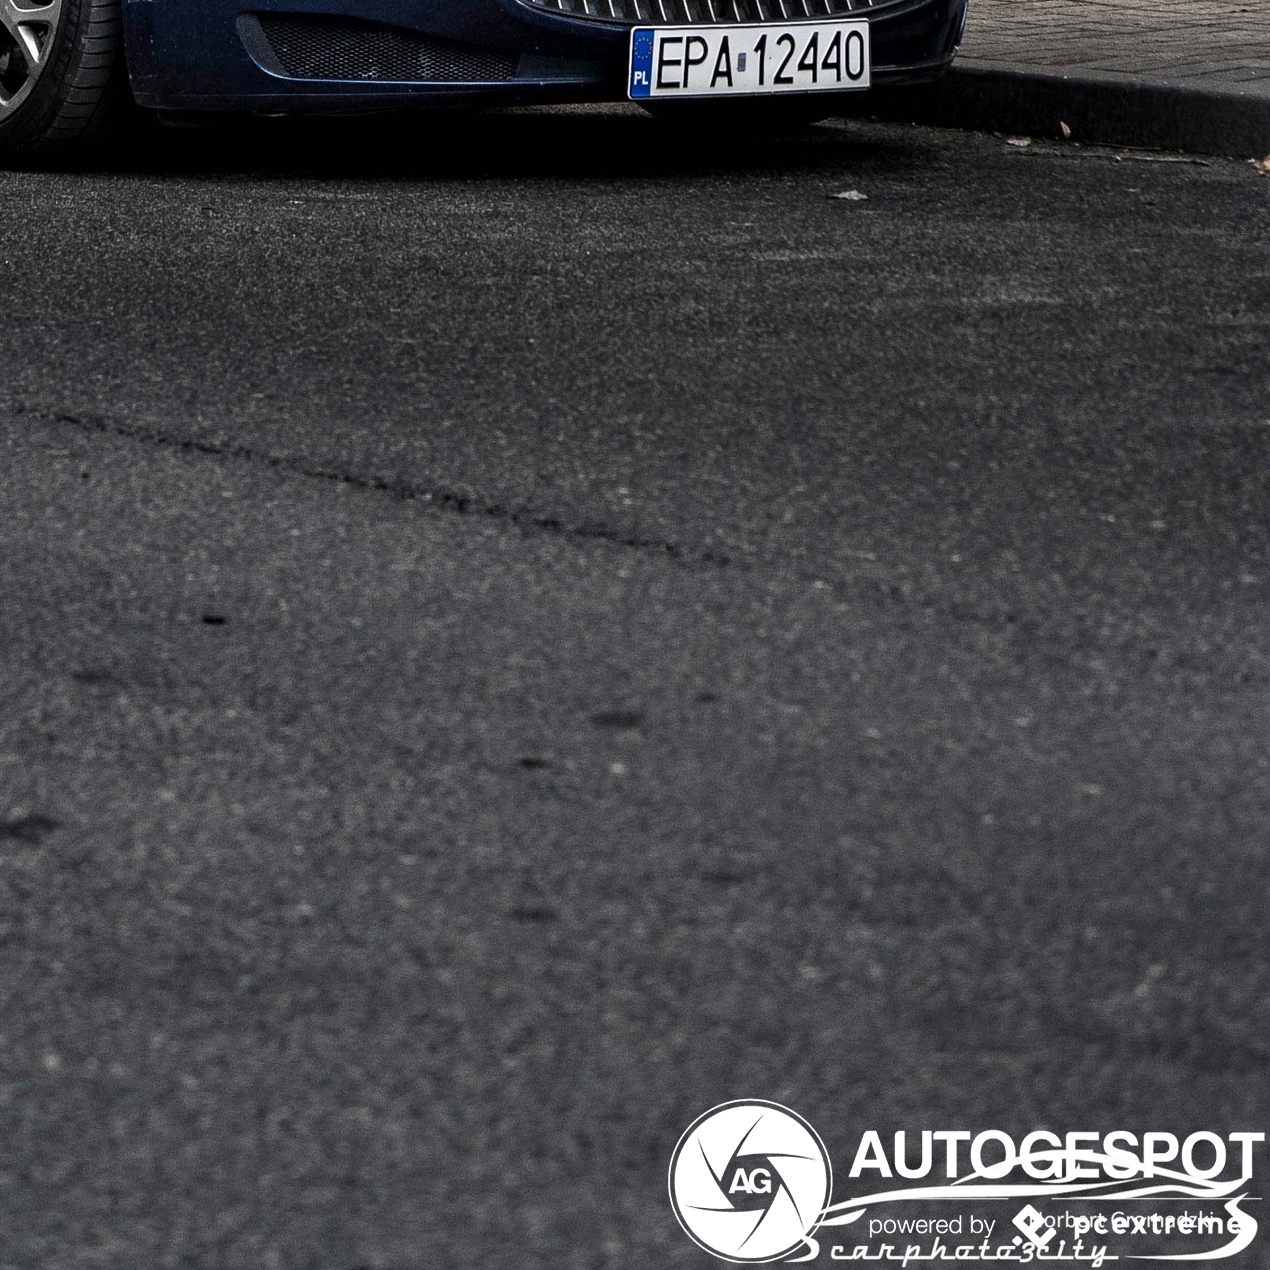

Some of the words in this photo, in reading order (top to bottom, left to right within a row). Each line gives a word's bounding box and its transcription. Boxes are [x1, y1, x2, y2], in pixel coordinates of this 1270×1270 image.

[633, 70, 649, 86] PL
[655, 35, 734, 89] EPA
[753, 30, 865, 86] 12440
